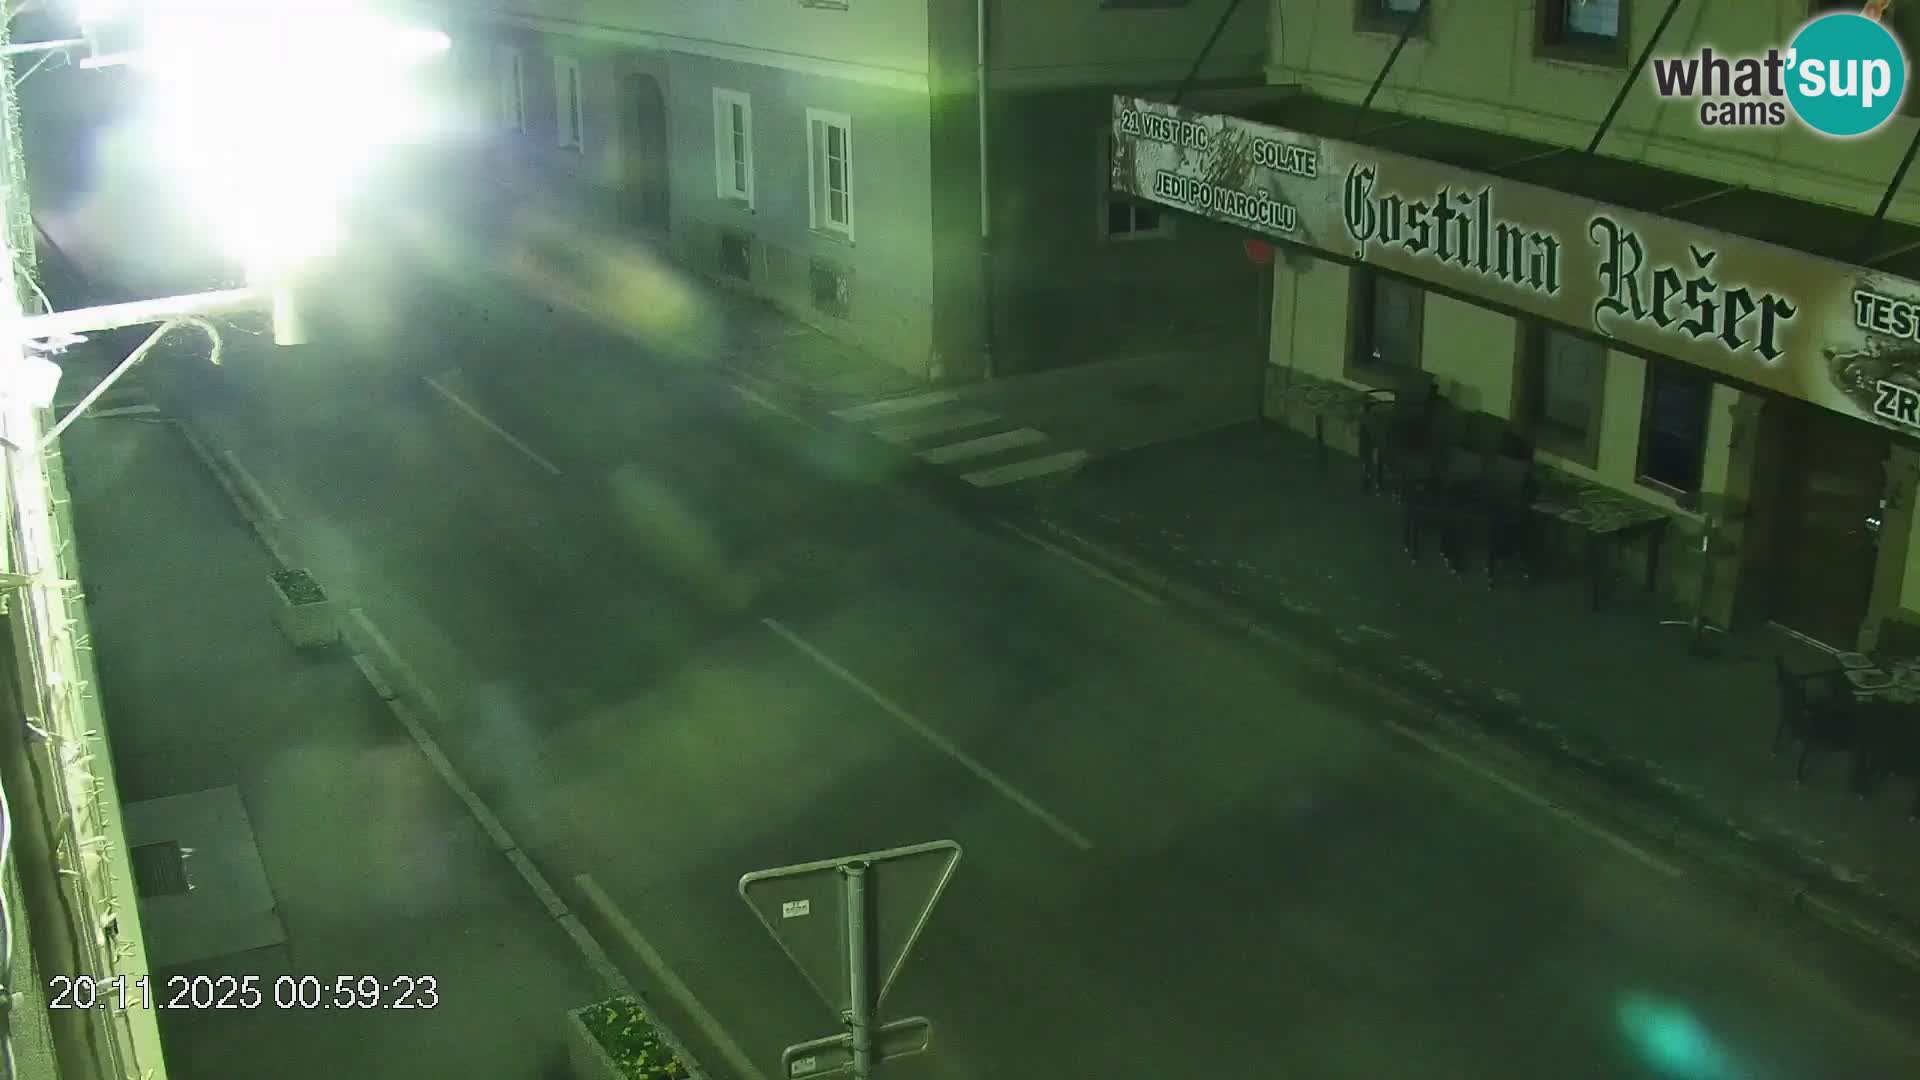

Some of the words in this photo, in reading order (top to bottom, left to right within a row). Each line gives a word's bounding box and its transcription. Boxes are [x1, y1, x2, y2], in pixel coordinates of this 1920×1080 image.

[1121, 110, 1141, 136] 21
[1142, 113, 1181, 144] VRST
[1253, 138, 1317, 179] SOLATE
[1155, 170, 1187, 203] JEDI
[1188, 179, 1213, 208] PO
[1213, 186, 1297, 232] NAROČILU
[1343, 161, 1562, 295] Gostilna
[1590, 215, 1798, 363] Rešer
